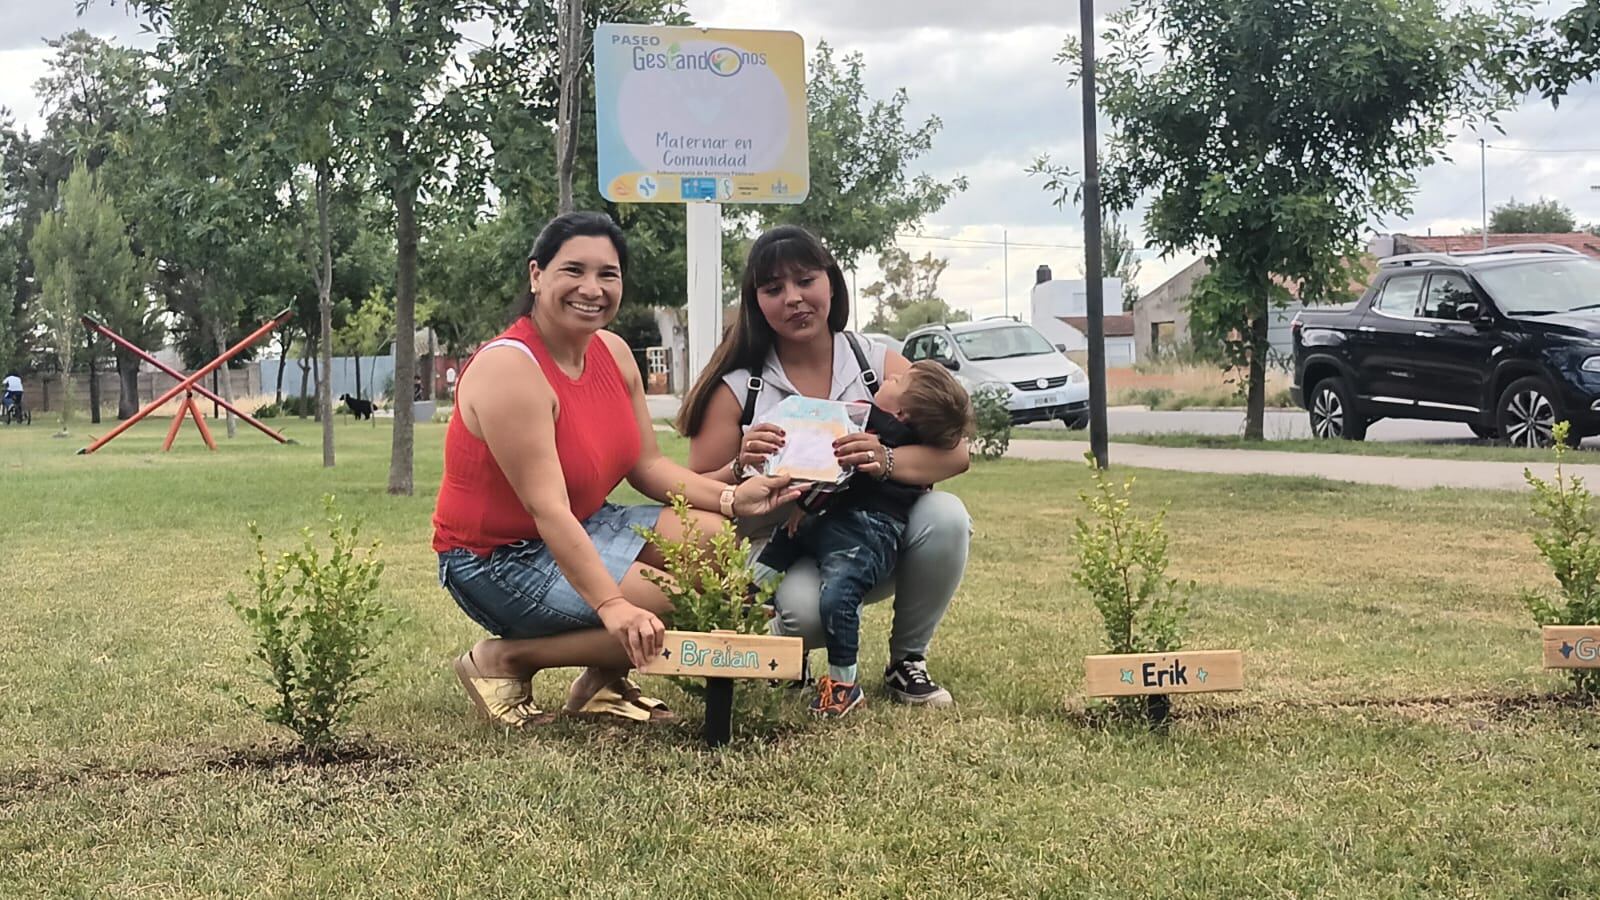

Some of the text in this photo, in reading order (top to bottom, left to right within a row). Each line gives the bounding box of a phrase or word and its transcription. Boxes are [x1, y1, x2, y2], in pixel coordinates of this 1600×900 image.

[611, 35, 660, 46] PASEO
[656, 131, 752, 150] Maternar en
[663, 150, 747, 167] Comunidad
[680, 640, 759, 669] Braian
[1575, 636, 1600, 661] G
[1142, 659, 1187, 687] Erik
